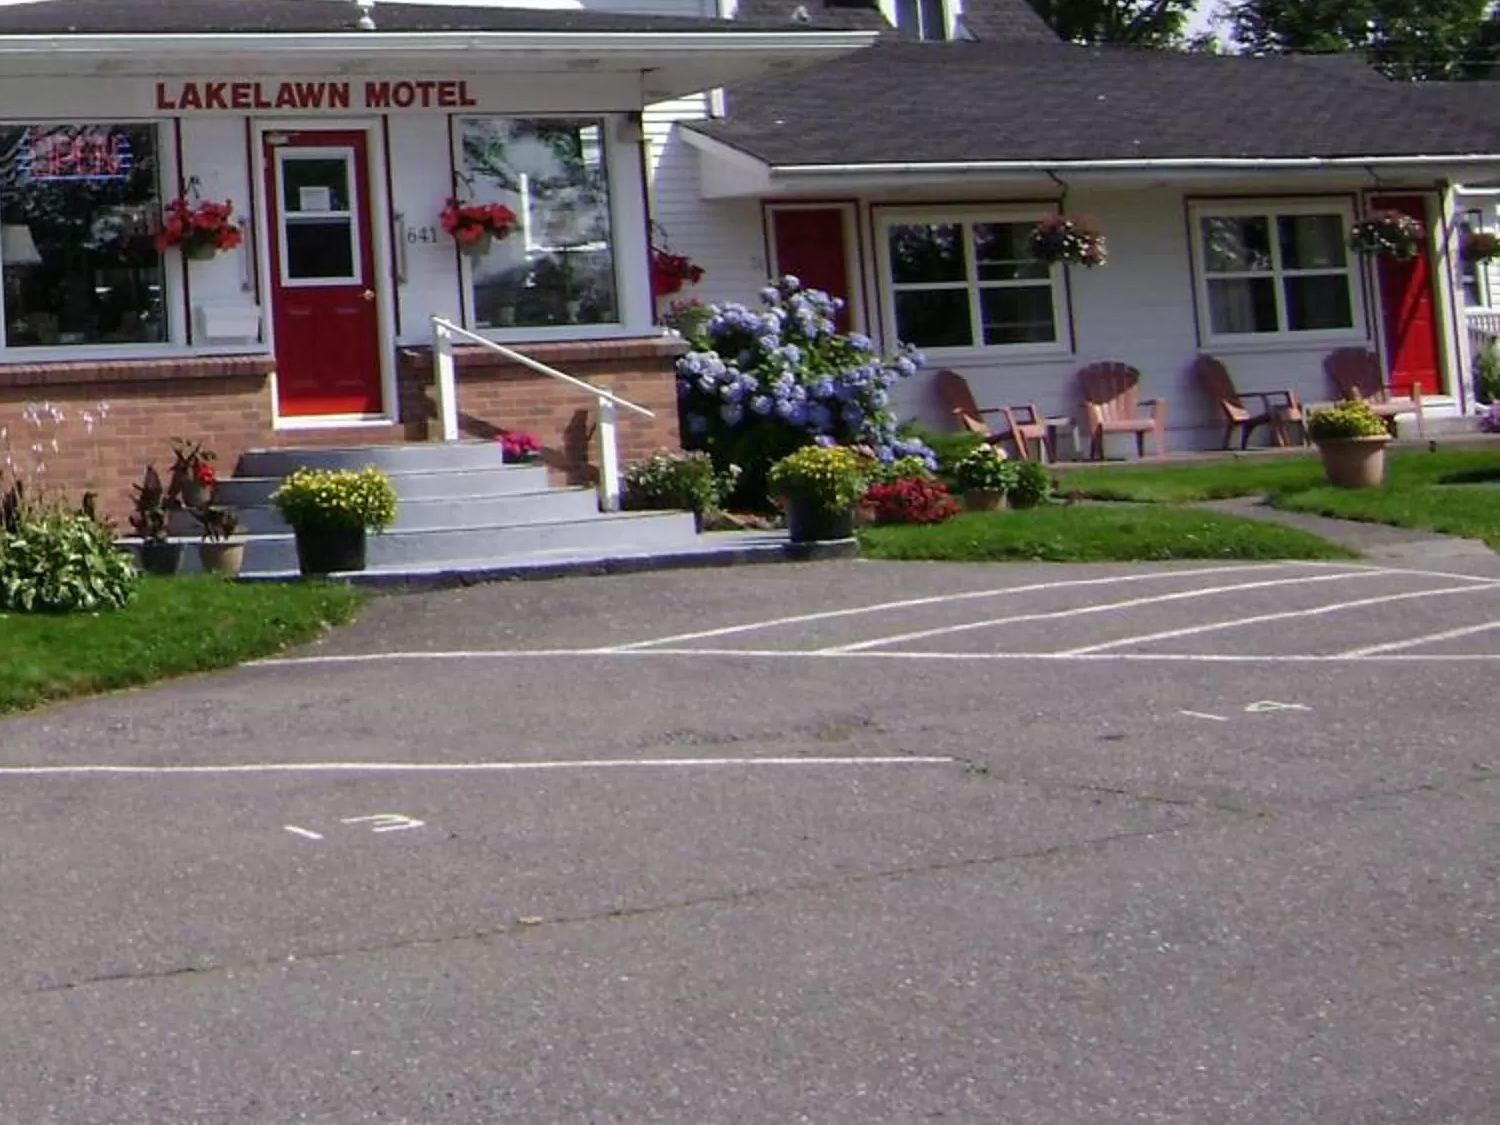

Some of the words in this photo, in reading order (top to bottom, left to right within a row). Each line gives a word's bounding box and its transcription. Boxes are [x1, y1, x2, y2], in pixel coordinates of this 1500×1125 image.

[156, 81, 350, 110] LAKELAWN
[364, 80, 476, 108] MOTEL
[407, 226, 437, 244] 641
